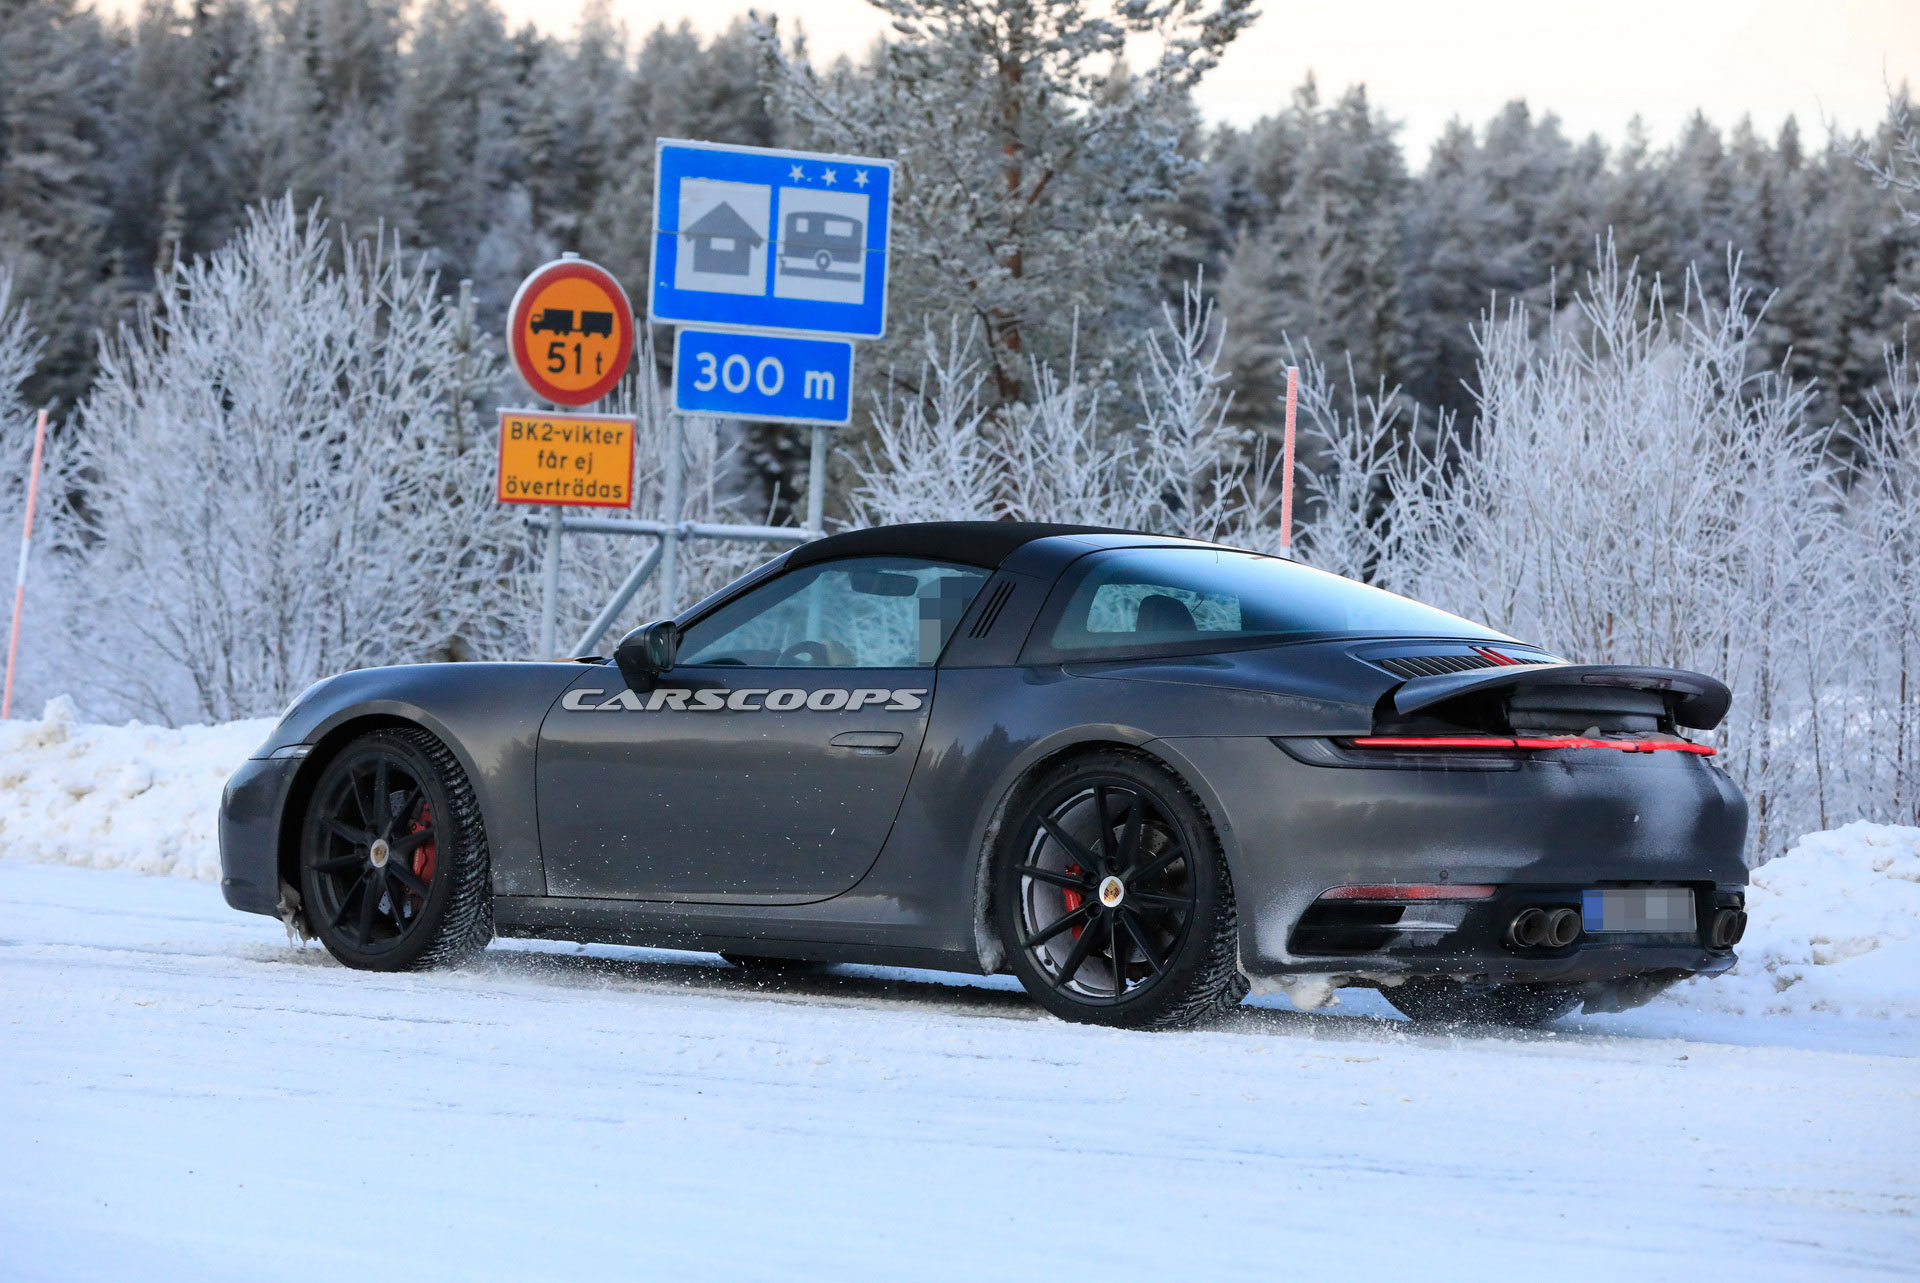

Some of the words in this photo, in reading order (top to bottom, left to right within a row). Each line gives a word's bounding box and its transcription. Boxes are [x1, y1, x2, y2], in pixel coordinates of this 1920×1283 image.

[547, 342, 582, 375] 51
[595, 352, 603, 376] t
[693, 352, 784, 396] 300
[803, 370, 835, 400] m
[511, 421, 624, 445] BK2-vikter
[538, 449, 568, 469] får
[575, 452, 593, 475] ej
[506, 475, 622, 499] överträdas
